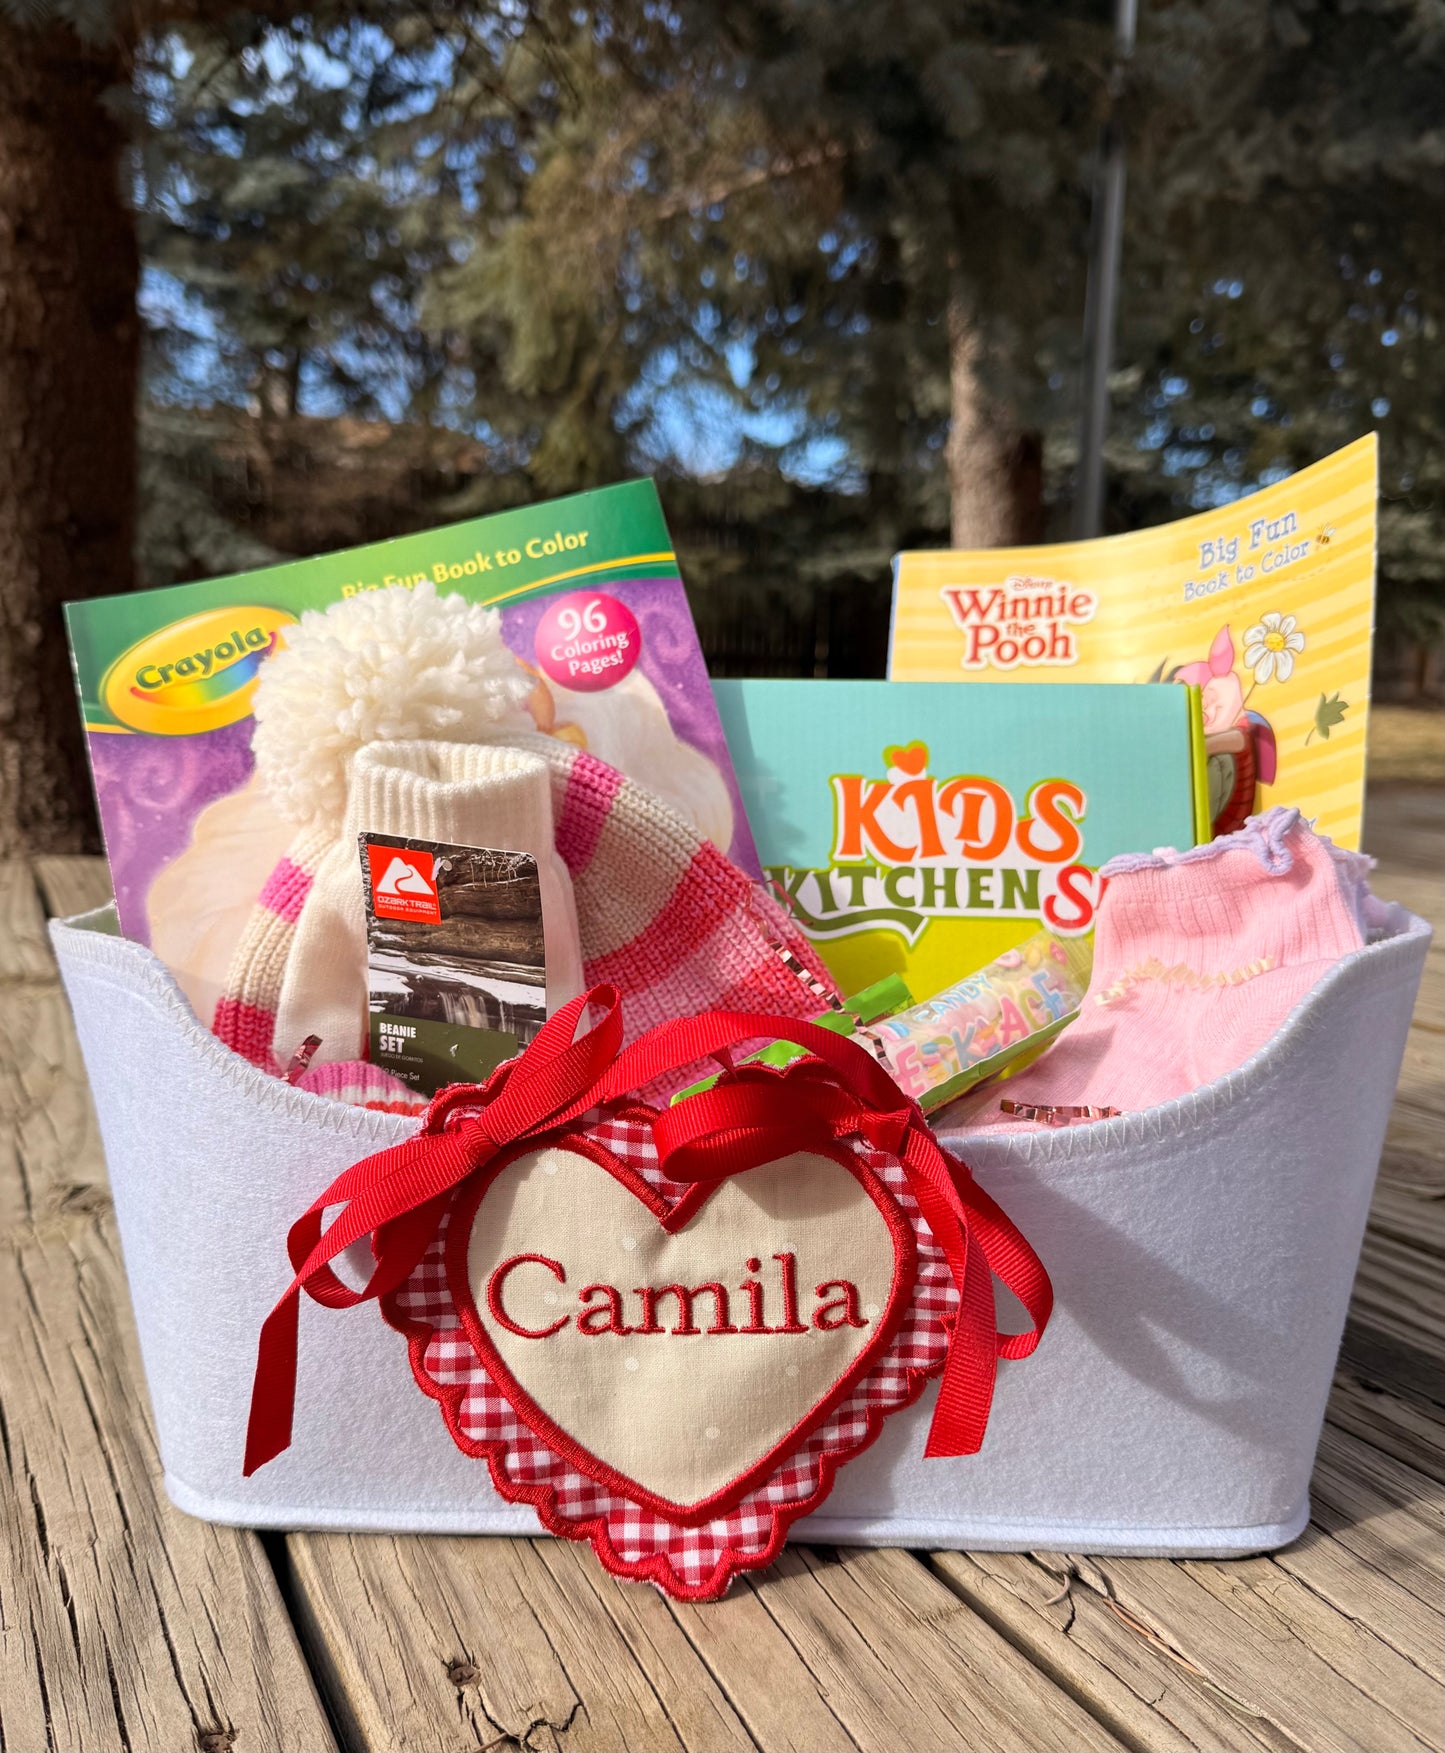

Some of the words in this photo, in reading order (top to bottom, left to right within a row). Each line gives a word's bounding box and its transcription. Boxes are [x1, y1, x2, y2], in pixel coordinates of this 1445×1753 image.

[432, 551, 493, 584] Book
[495, 546, 522, 568] to
[525, 530, 589, 560] Color
[1199, 536, 1239, 570] Big
[1249, 511, 1297, 550] Fun
[1184, 571, 1229, 602] Book
[1235, 563, 1256, 583] to
[1261, 540, 1310, 573] Color
[557, 600, 607, 642] 96
[945, 586, 1092, 622] Winnie
[551, 632, 630, 662] Coloring
[967, 622, 1071, 664] Pooh
[1006, 622, 1036, 637] the
[135, 627, 269, 690] Crayola
[568, 649, 625, 677] Pages!
[835, 747, 1086, 864] KIDS
[379, 1022, 417, 1039] BEANIE
[379, 1034, 405, 1054] SET
[409, 1071, 420, 1081] Set
[487, 1252, 869, 1339] Camila
